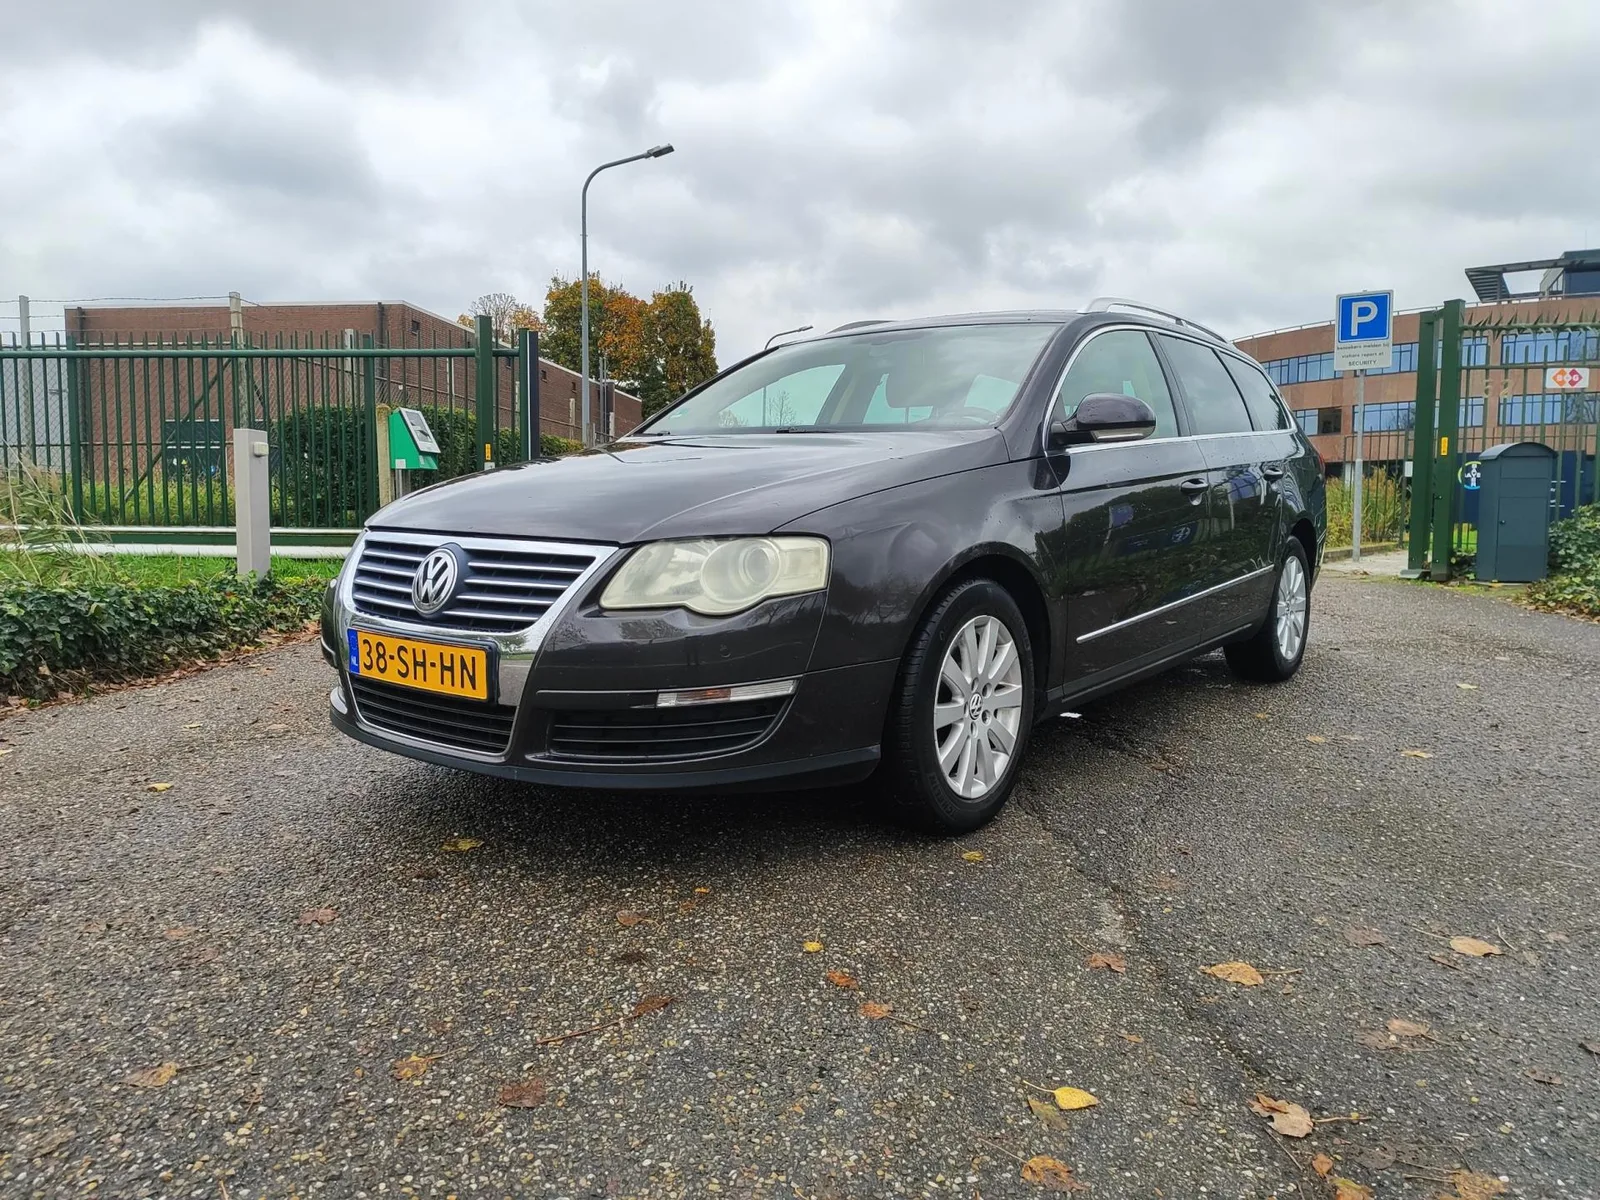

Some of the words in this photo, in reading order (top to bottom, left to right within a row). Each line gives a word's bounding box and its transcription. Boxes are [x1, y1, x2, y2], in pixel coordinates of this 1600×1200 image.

[1351, 301, 1378, 337] P
[1348, 359, 1377, 367] SECURITY
[351, 655, 359, 667] NL
[362, 638, 477, 691] 38-SH-HN
